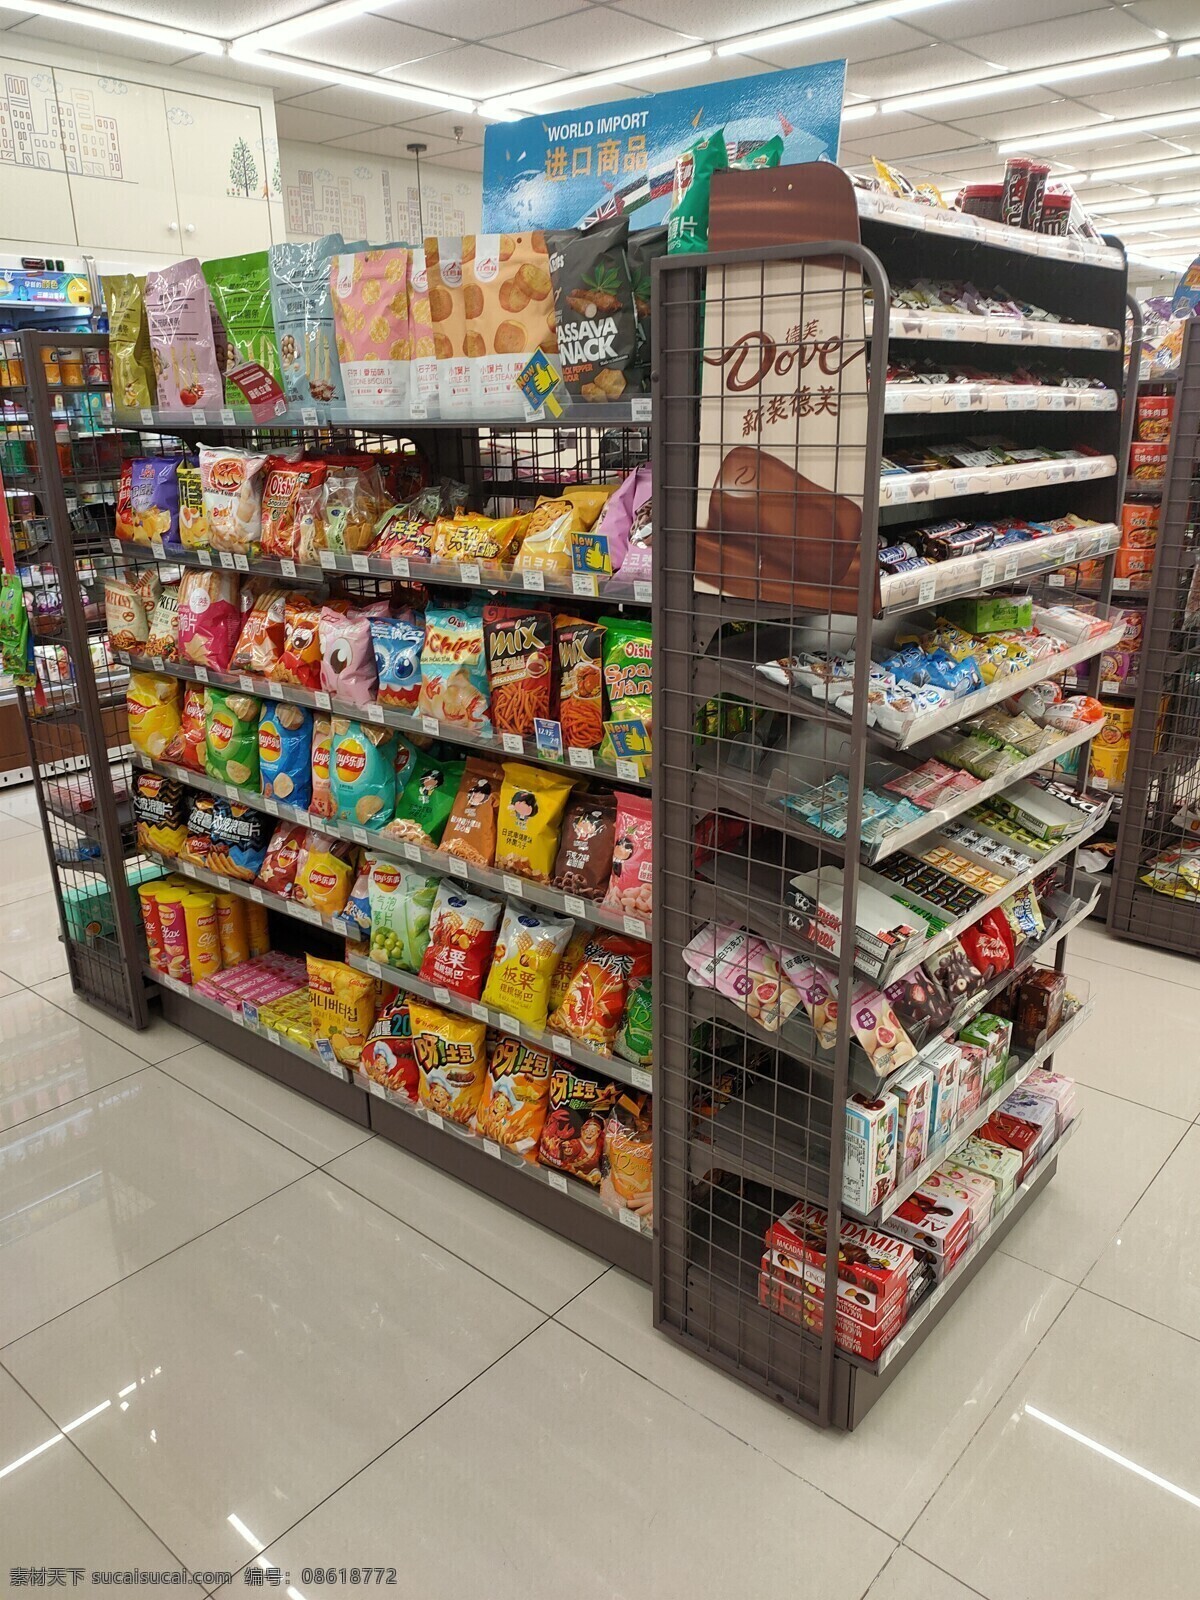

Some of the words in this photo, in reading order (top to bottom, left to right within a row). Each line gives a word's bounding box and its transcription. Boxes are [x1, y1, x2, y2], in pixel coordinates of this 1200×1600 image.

[548, 121, 593, 141] WORLD
[597, 111, 649, 137] IMPORT
[544, 135, 649, 183] 进口商品
[556, 316, 618, 344] ASSAVA
[558, 334, 618, 366] NACK
[703, 330, 865, 392] Dove
[516, 364, 535, 390] New
[270, 475, 296, 497] Oishi
[571, 534, 593, 547] New
[447, 616, 466, 628] Oishi
[430, 633, 482, 660] Chips
[625, 642, 653, 659] Oishi
[604, 662, 653, 685] Sna
[606, 723, 629, 734] New
[376, 895, 397, 912] 气泡
[705, 934, 745, 974] 草莓白巧克力
[503, 965, 540, 993] 板栗
